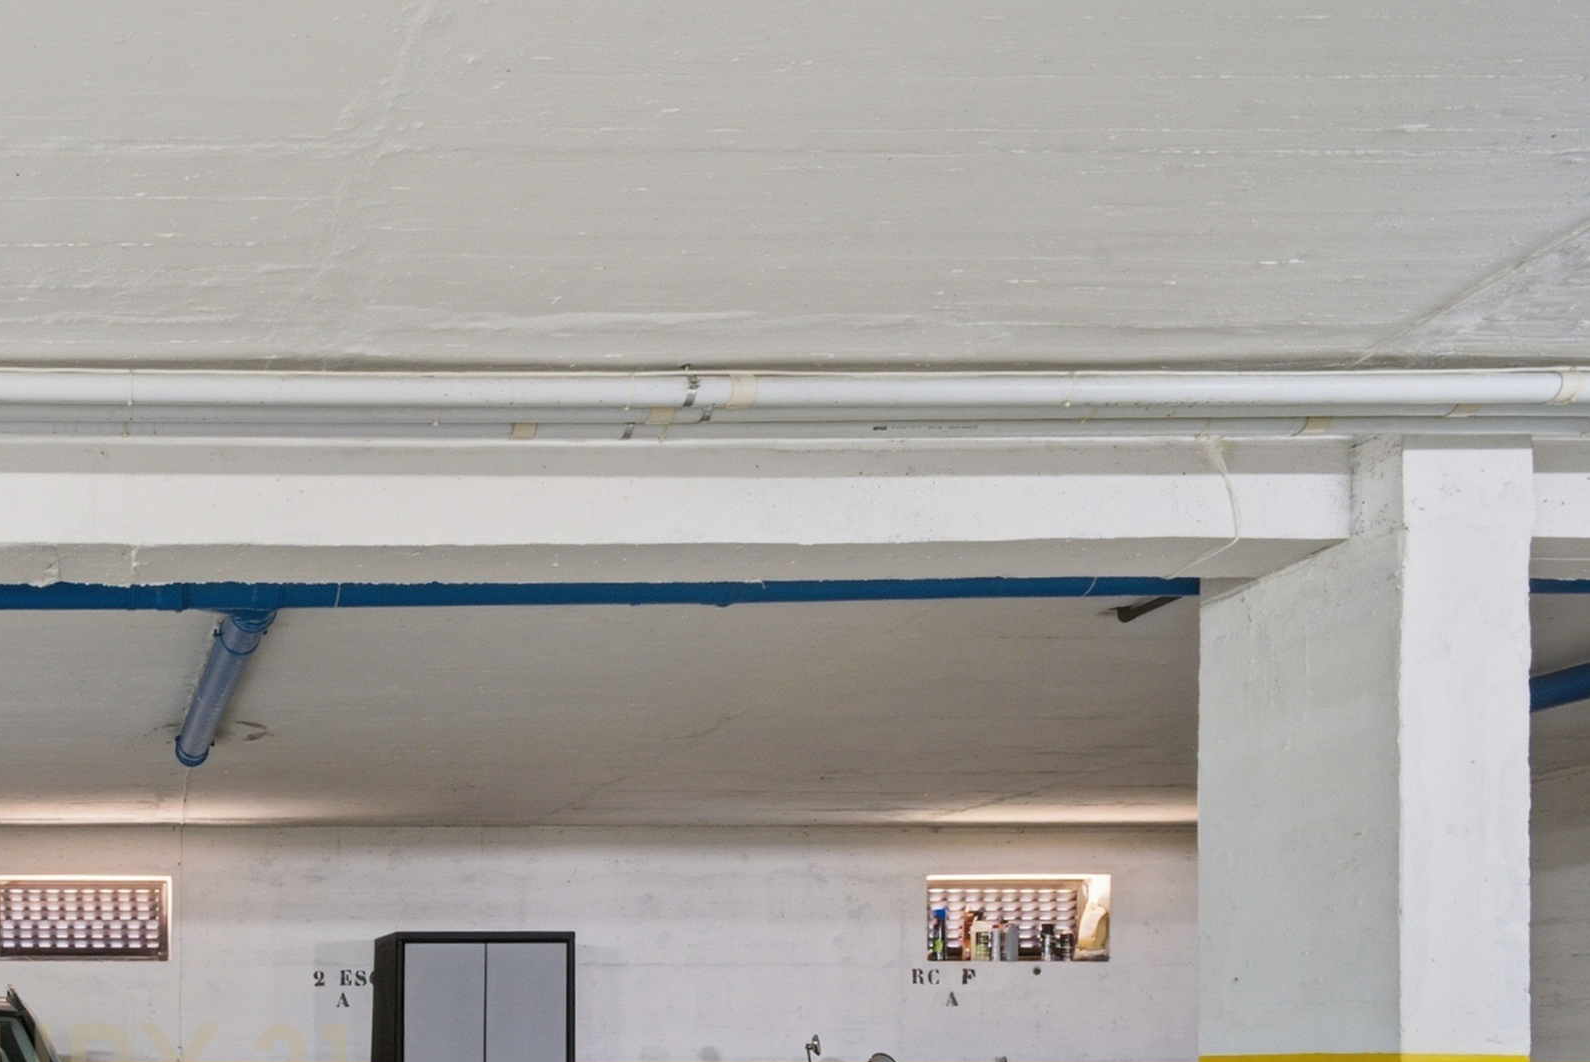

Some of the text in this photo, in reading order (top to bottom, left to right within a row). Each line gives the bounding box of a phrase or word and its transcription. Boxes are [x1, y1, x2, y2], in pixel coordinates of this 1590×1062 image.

[313, 970, 325, 987] 2
[912, 968, 940, 985] RC
[336, 992, 350, 1008] A
[945, 991, 959, 1007] A
